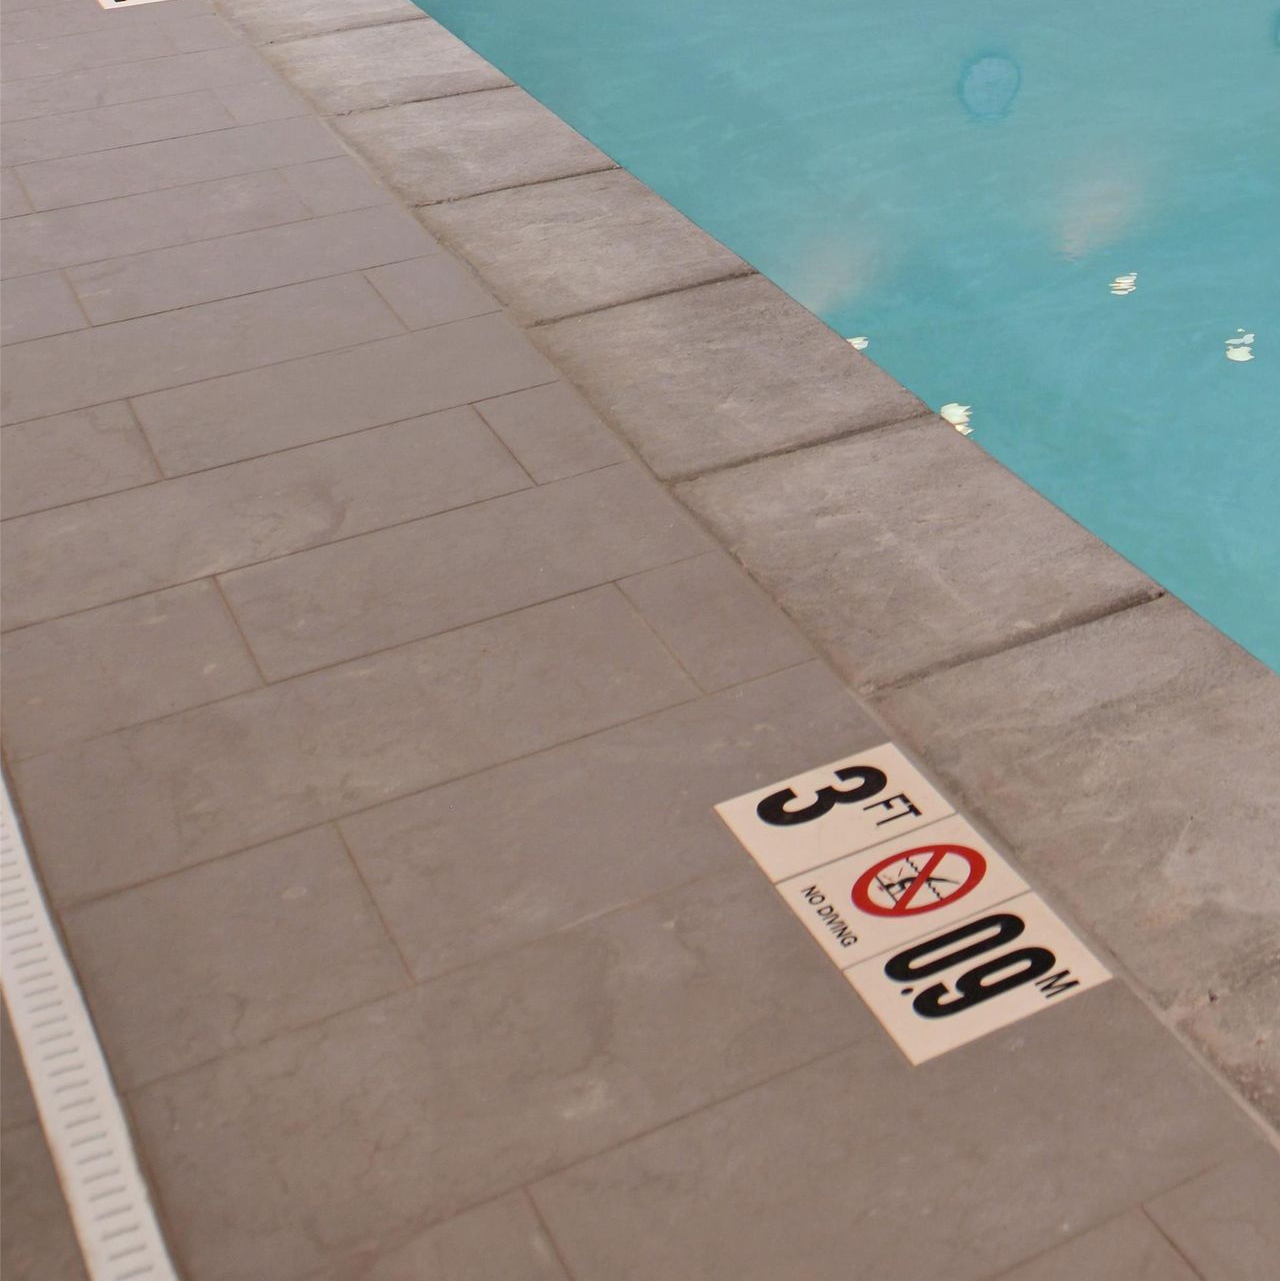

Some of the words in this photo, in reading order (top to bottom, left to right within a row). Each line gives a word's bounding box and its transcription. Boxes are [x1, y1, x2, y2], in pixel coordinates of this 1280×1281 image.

[756, 765, 888, 827] 3
[863, 793, 922, 827] FT
[801, 885, 825, 905] NO
[816, 905, 858, 949] DIVING
[1034, 969, 1081, 999] M
